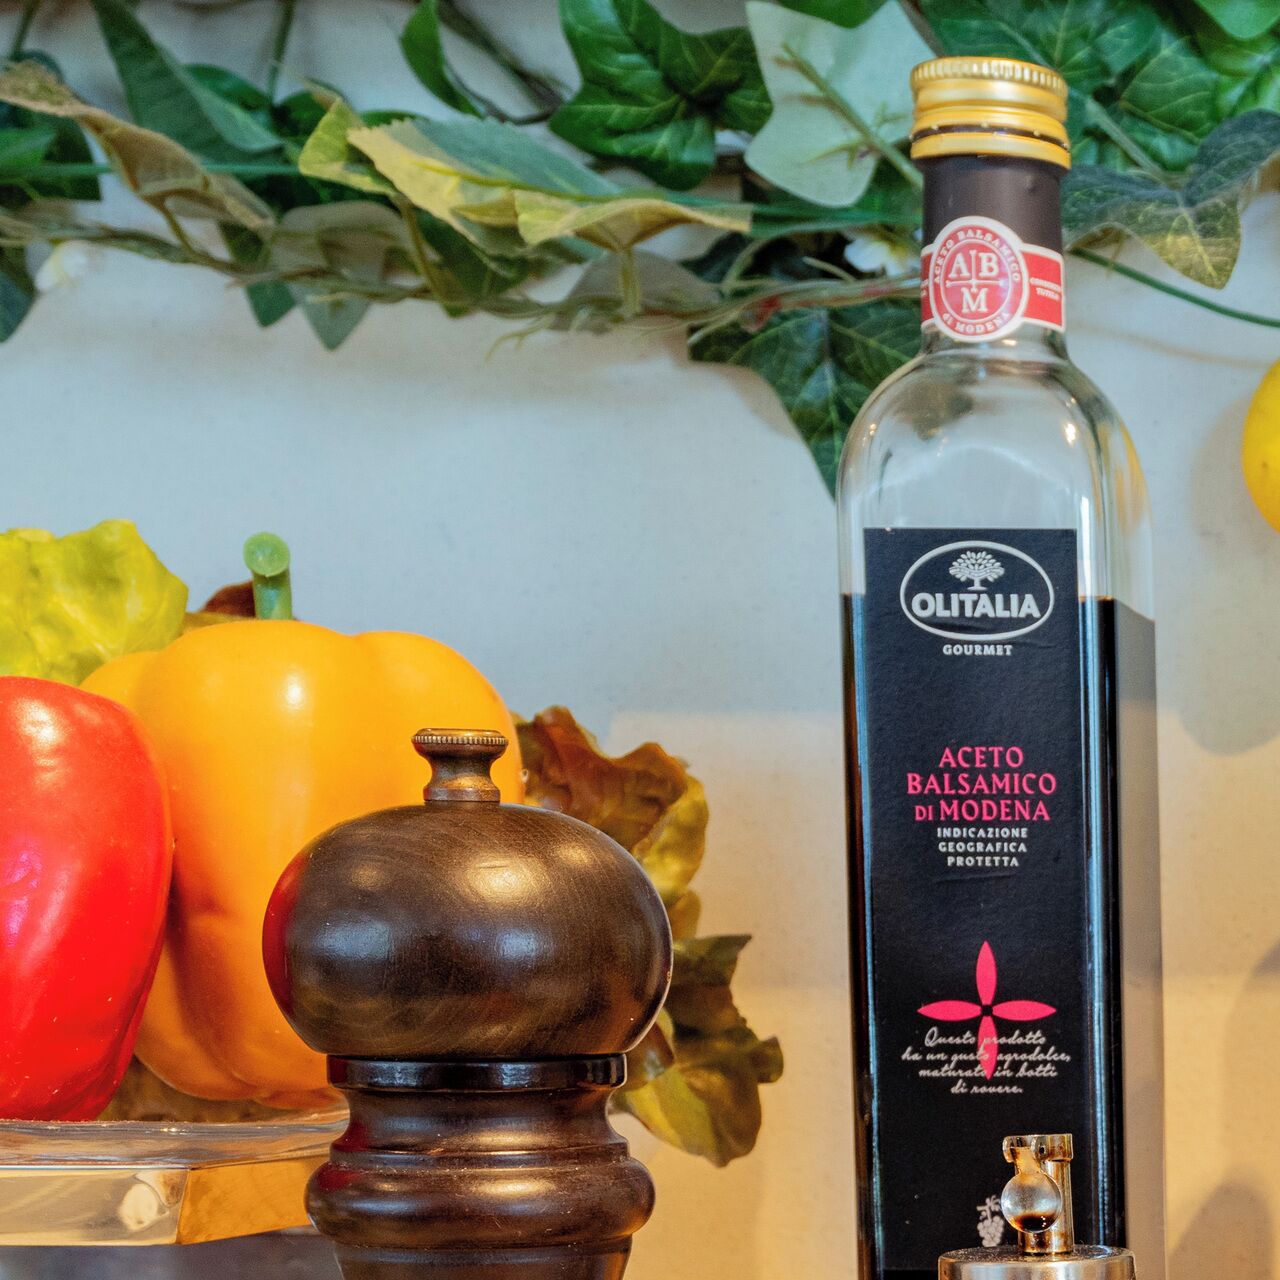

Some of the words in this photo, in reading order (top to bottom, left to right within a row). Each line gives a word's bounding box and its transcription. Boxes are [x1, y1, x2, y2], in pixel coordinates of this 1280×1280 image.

[956, 228, 1021, 284] BALSAMICO
[955, 311, 1010, 333] MODENA
[911, 592, 1041, 618] OLITALIA
[942, 643, 1013, 656] GOURMET
[938, 746, 1024, 768] ACETO
[907, 773, 1057, 794] BALSAMICO
[915, 805, 933, 821] DI
[939, 800, 1051, 821] MODENA
[937, 828, 1028, 838] INDICAZIONE
[938, 842, 1027, 852] GEOGRAFICA
[947, 857, 1019, 867] PROTETTA
[924, 1026, 977, 1047] Questo
[983, 1029, 1047, 1049] prodotto
[902, 1046, 923, 1061] ha
[926, 1052, 947, 1061] un
[951, 1045, 989, 1070] gusto
[918, 1062, 988, 1078] maturato
[994, 1065, 1013, 1077] in
[1016, 1062, 1058, 1078] botti
[951, 1078, 968, 1094] di
